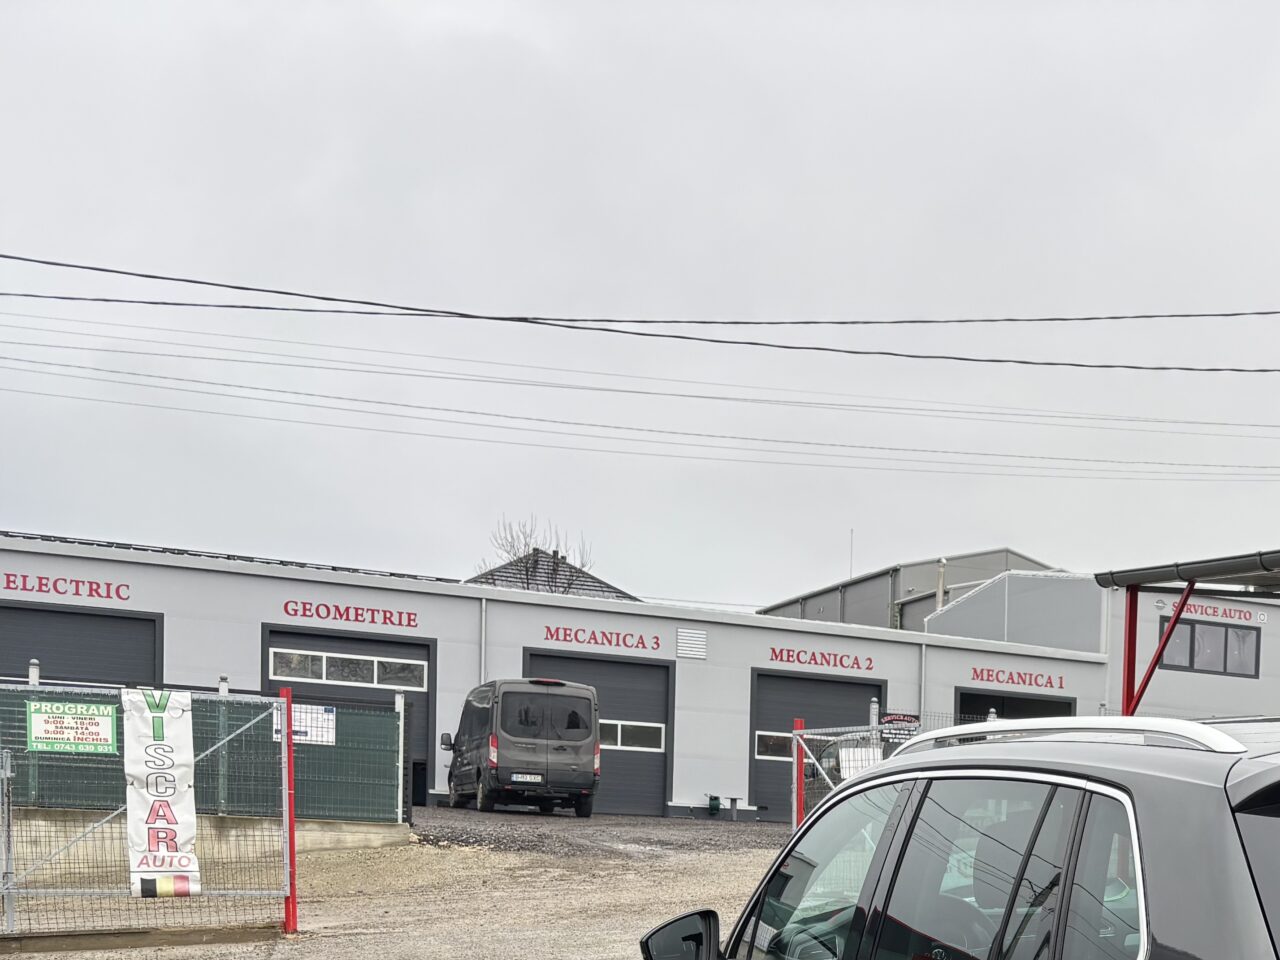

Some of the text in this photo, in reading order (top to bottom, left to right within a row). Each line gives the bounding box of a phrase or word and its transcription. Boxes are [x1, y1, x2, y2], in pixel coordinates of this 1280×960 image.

[3, 573, 130, 600] ELECTRIC
[283, 600, 418, 627] GEOMETRIE
[1172, 601, 1252, 621] SRVICE AUTO
[544, 626, 660, 650] MECANICA 3
[769, 647, 873, 670] MECANICA 2
[971, 667, 1064, 689] MECANICA 1
[31, 703, 112, 716] PROGRAM
[54, 743, 76, 751] 0743
[137, 854, 191, 868] AUTO
